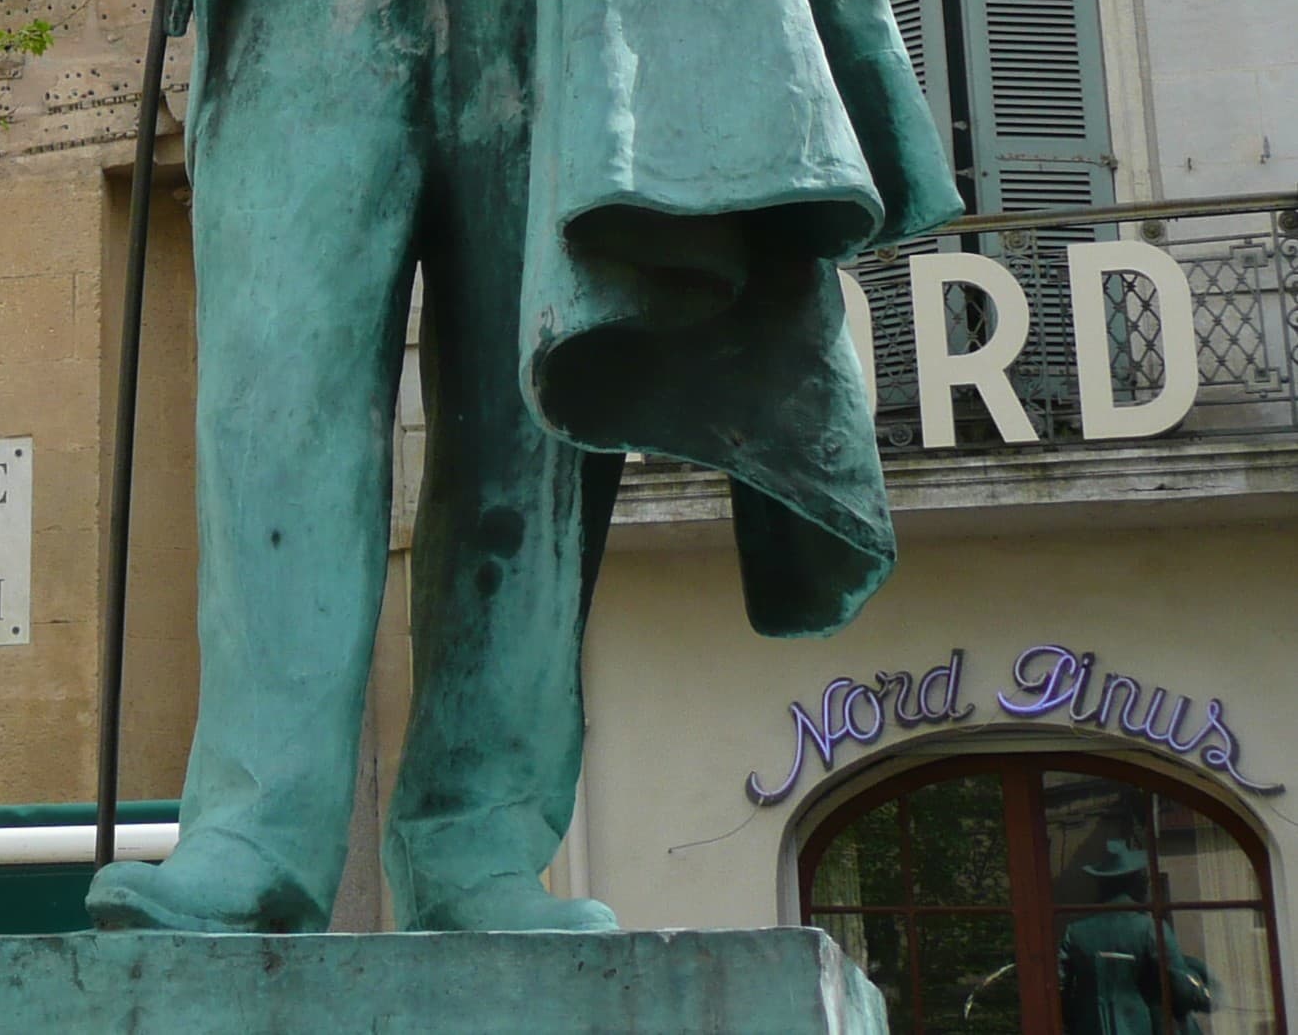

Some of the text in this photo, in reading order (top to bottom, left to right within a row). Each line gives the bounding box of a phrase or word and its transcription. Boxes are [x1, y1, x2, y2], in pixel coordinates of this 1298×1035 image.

[839, 240, 1199, 448] RD
[746, 644, 1285, 806] Nord Pinus
